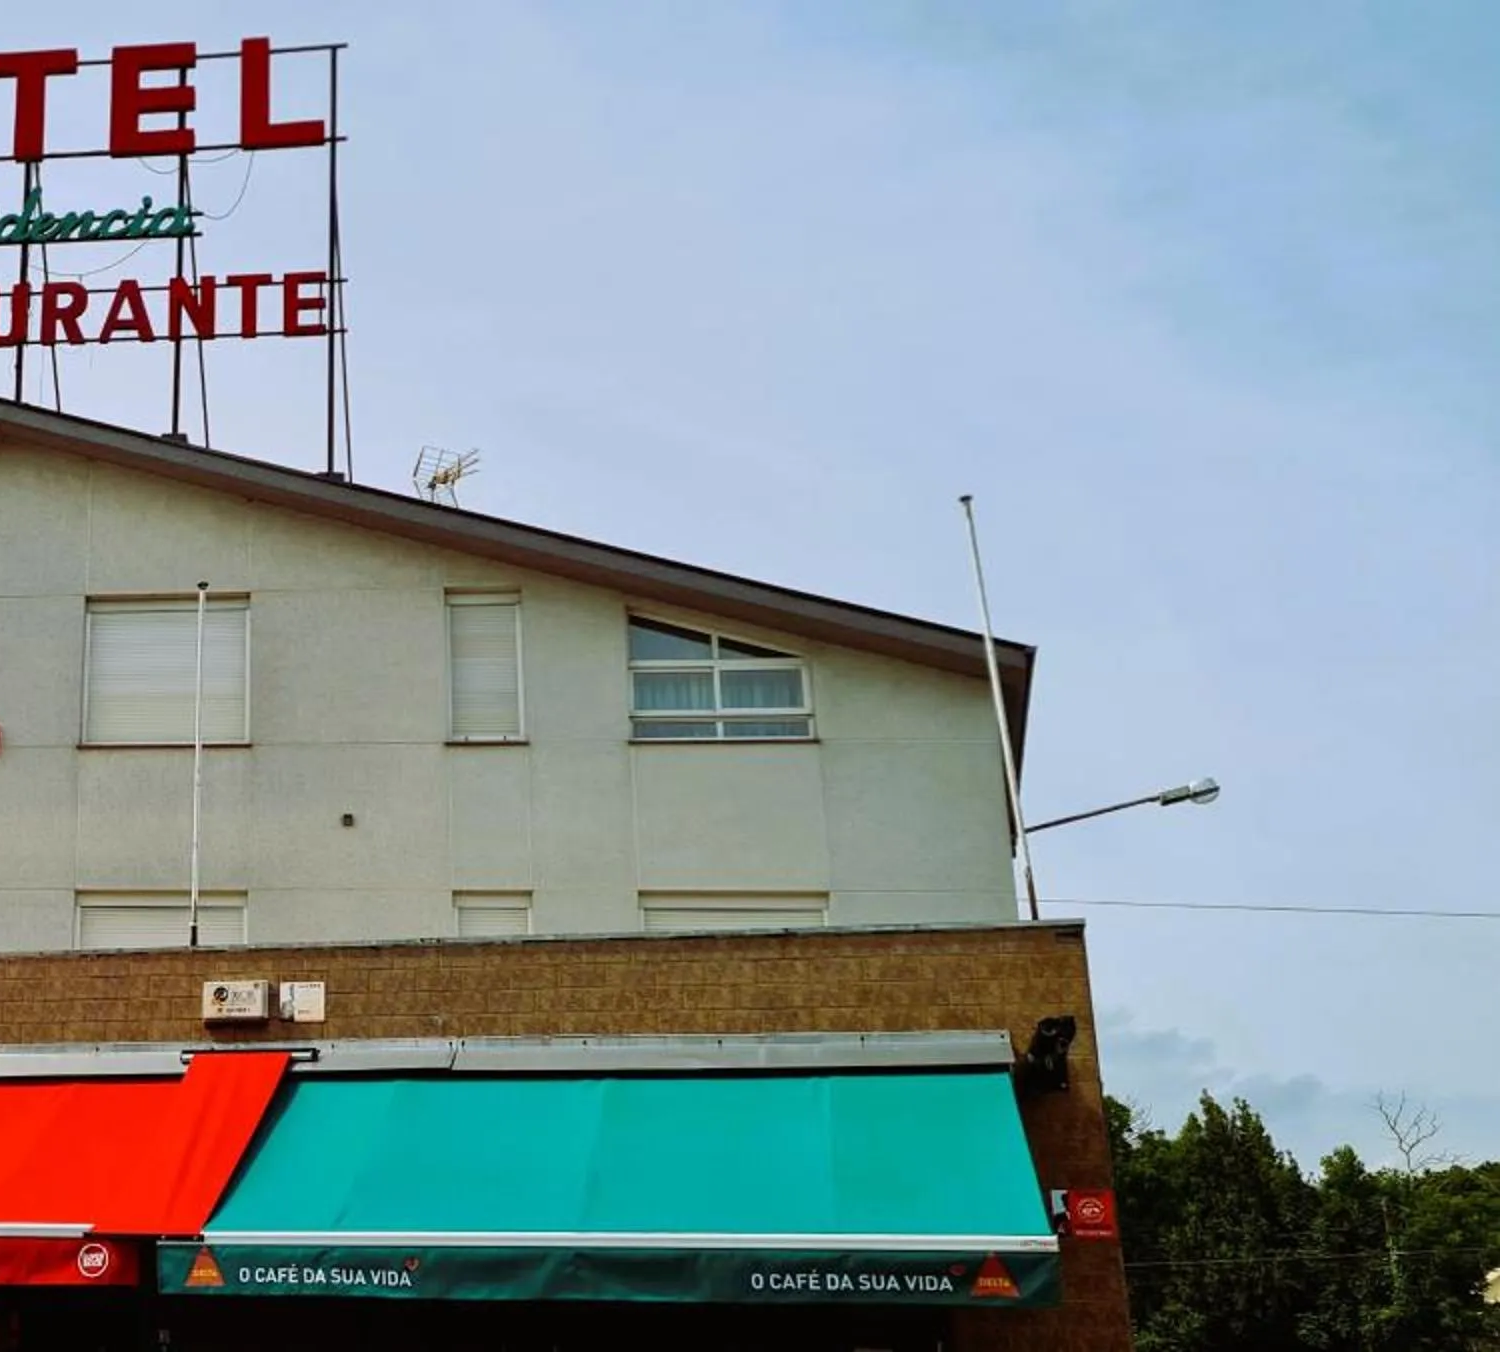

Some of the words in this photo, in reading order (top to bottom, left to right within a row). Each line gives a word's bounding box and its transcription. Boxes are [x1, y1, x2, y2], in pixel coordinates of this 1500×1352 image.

[239, 1267, 251, 1284] O
[254, 1264, 300, 1284] CAFÉ
[303, 1267, 328, 1285] DA
[330, 1268, 368, 1286] SUA
[370, 1269, 413, 1288] VIDA
[751, 1273, 764, 1290] O
[769, 1269, 821, 1290] CAFÉ
[826, 1273, 855, 1291] DA
[859, 1274, 901, 1292] SUA
[904, 1275, 954, 1293] VIDA
